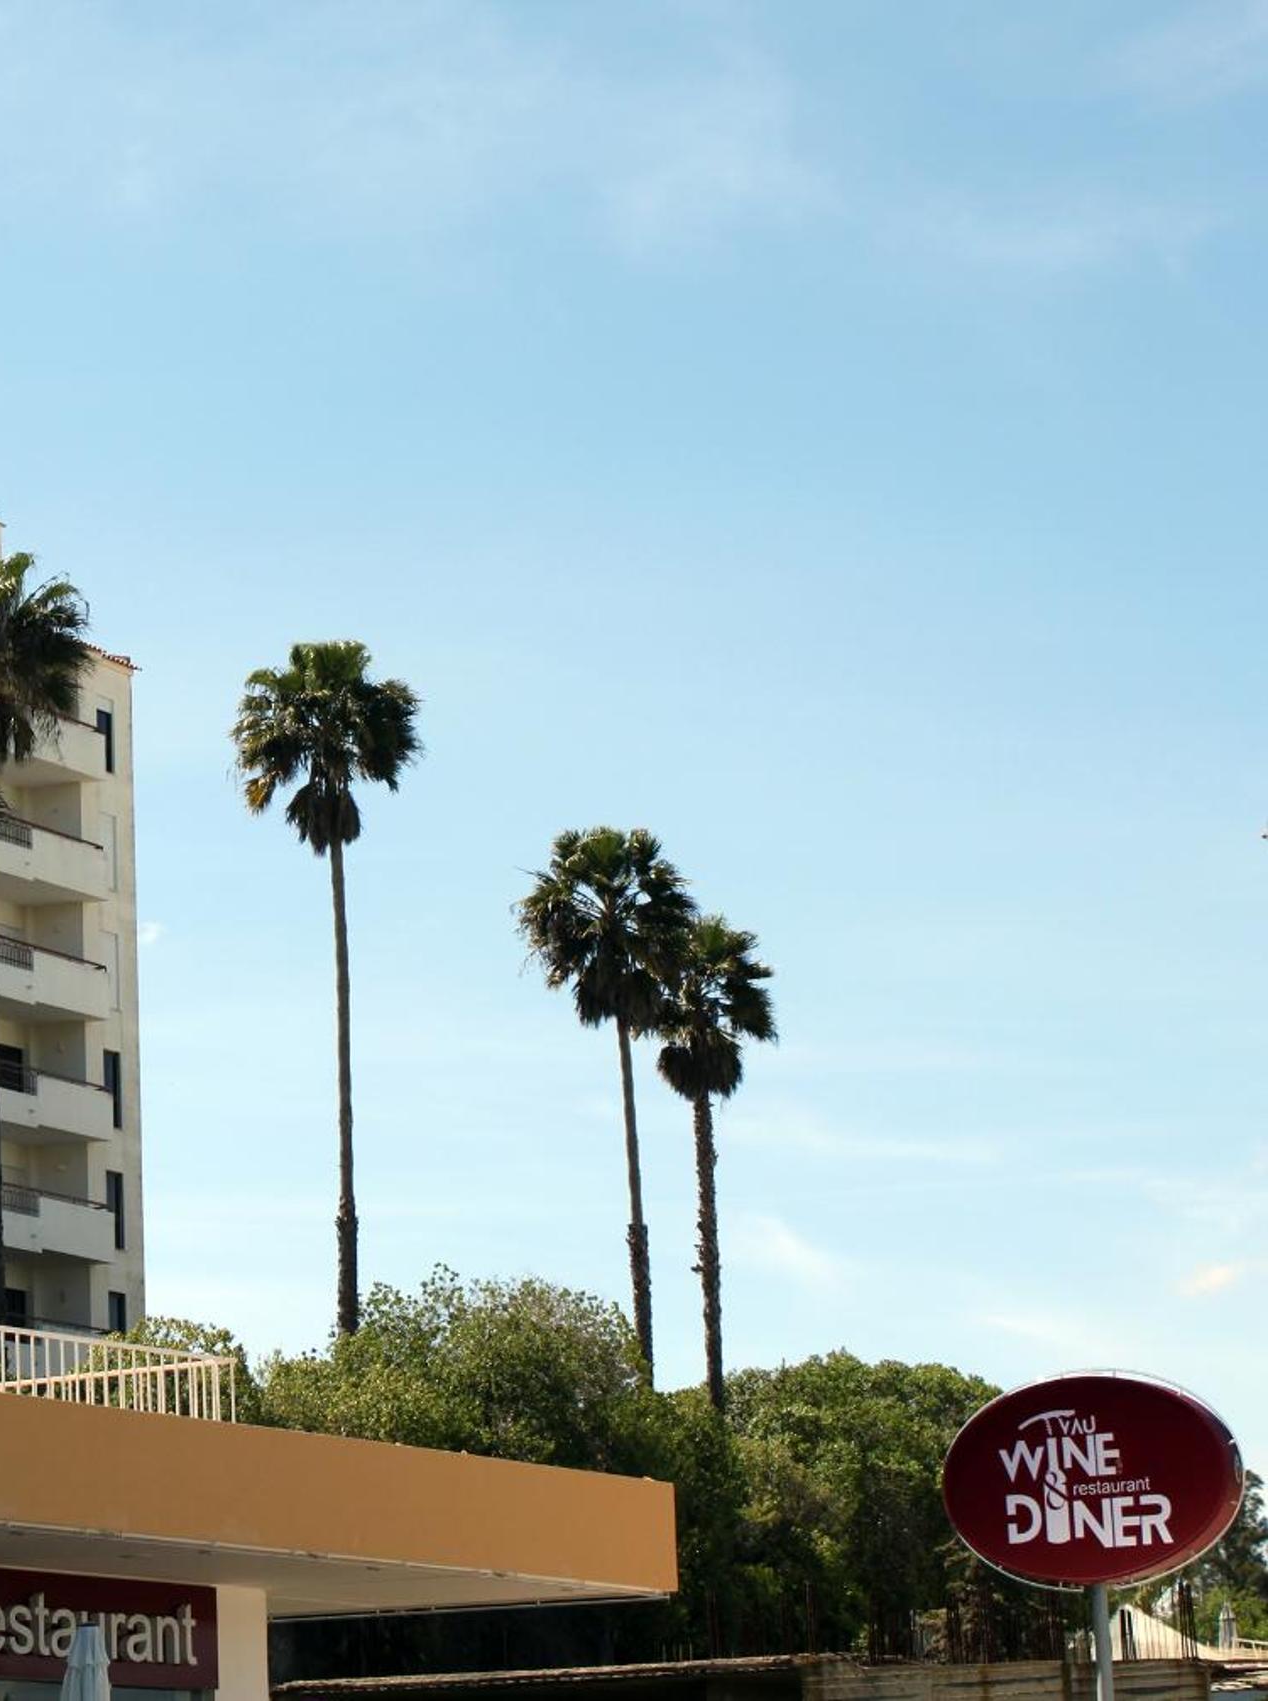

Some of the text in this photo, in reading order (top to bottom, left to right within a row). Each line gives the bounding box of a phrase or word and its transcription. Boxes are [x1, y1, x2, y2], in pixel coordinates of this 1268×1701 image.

[998, 1432, 1121, 1483] WINE
[1073, 1476, 1151, 1496] restaurant
[1004, 1494, 1174, 1548] DINER
